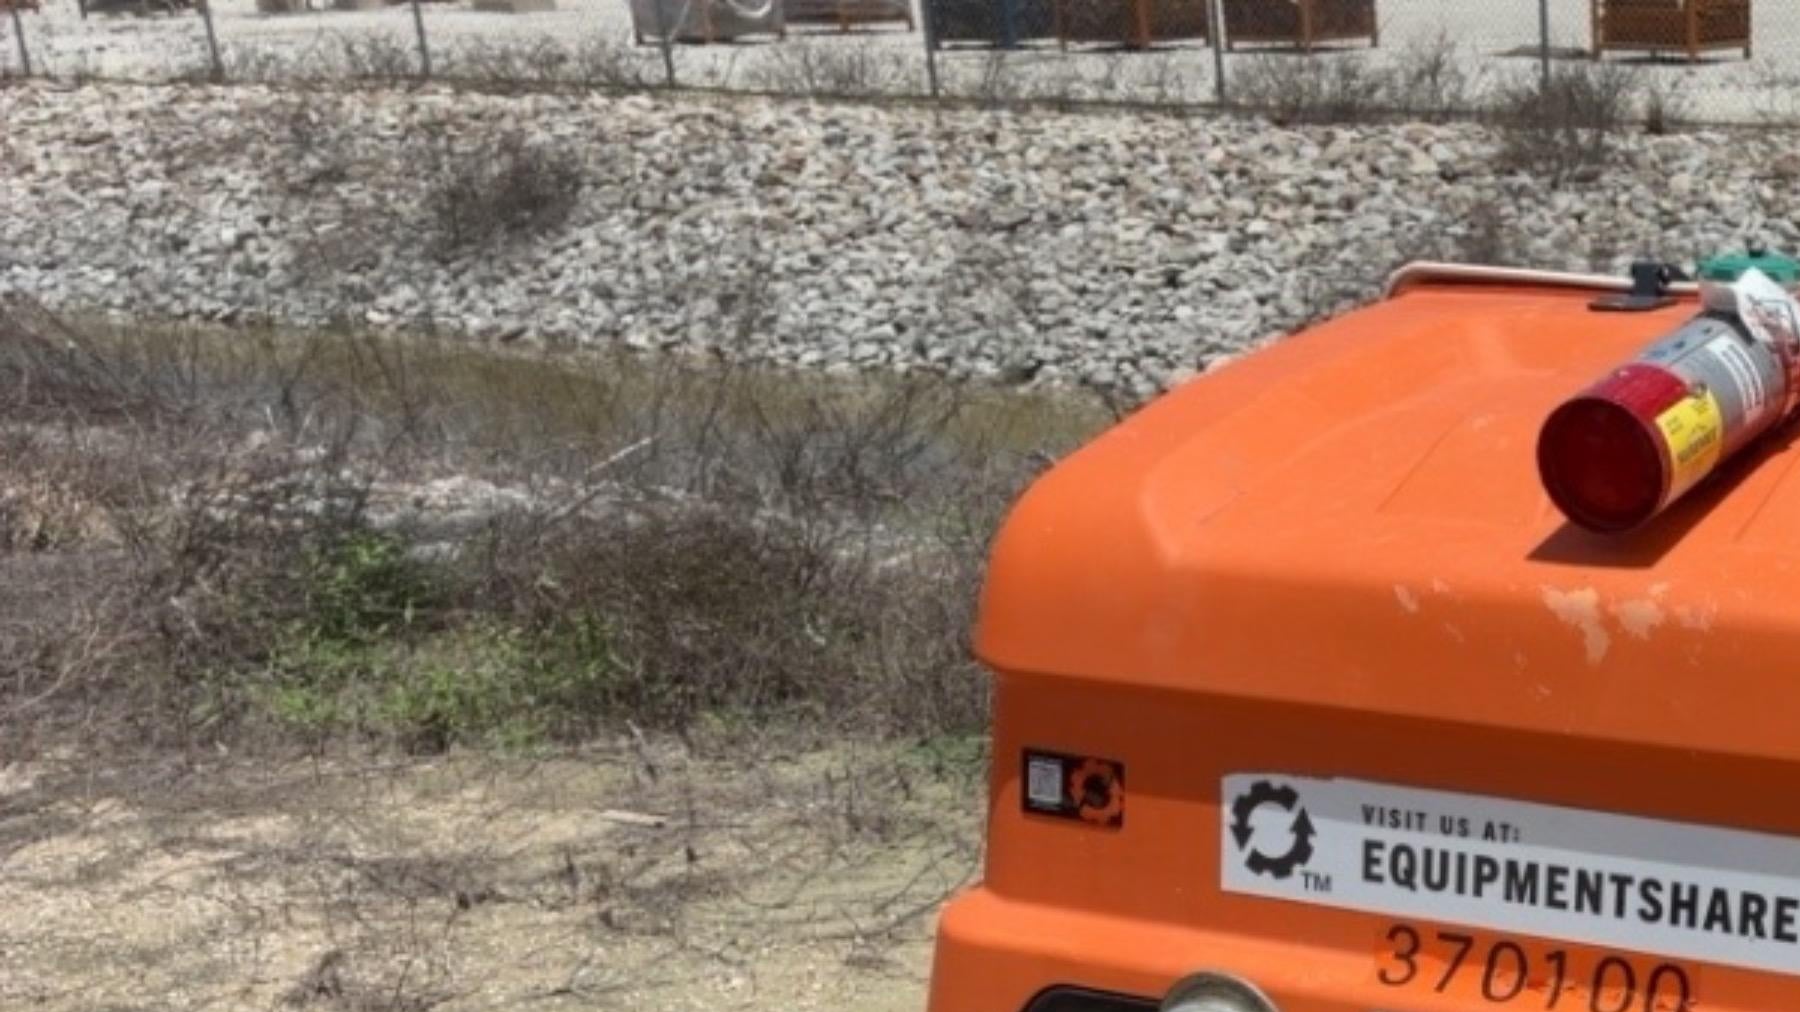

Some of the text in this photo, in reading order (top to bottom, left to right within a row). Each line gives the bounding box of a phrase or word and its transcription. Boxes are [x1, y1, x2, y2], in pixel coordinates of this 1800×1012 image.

[1361, 804, 1521, 844] VISIT US AT:
